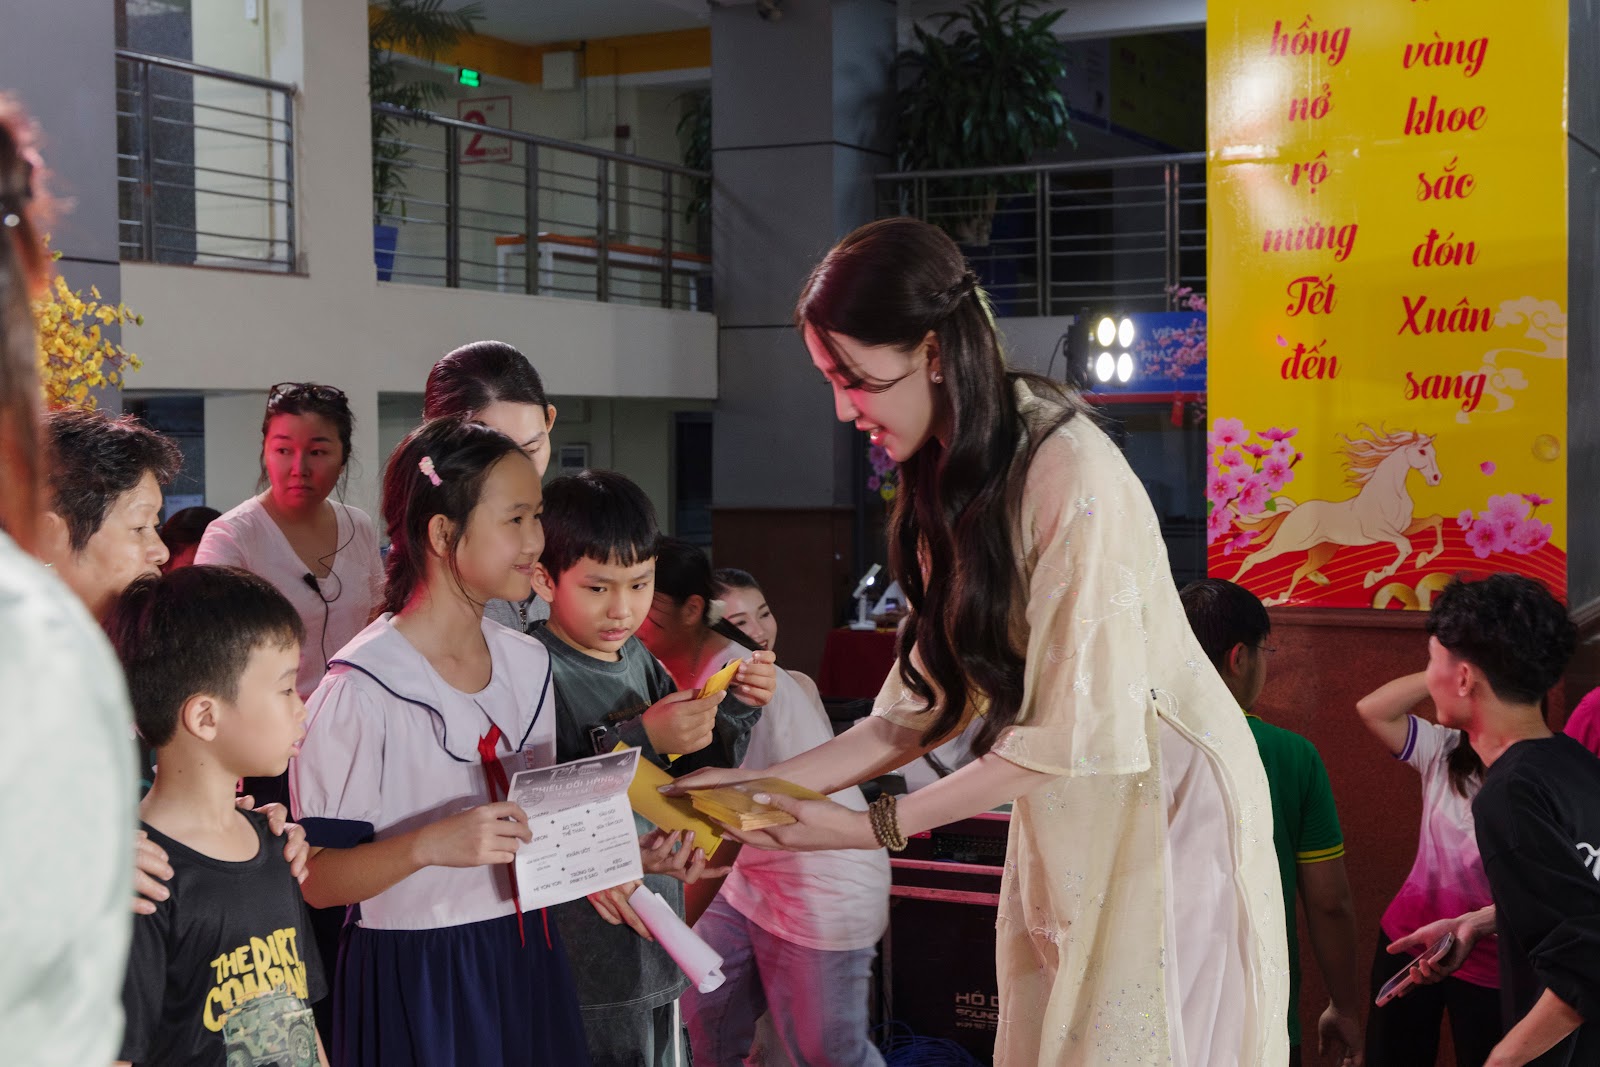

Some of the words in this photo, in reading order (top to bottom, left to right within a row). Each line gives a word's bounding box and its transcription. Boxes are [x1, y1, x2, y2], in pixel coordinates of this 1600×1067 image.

[1269, 14, 1352, 67] hồng
[1402, 31, 1489, 78] vàng
[1288, 82, 1334, 122] nở
[1403, 95, 1489, 136] khoe
[1290, 150, 1333, 195] rộ
[1416, 155, 1476, 202] sắc
[1262, 216, 1359, 263] mừng
[1412, 229, 1480, 268] đón
[1285, 273, 1337, 318] Tết
[1397, 295, 1496, 336] Xuân
[1280, 338, 1343, 380] đến
[1403, 371, 1488, 413] sang
[210, 945, 254, 984] THE
[250, 927, 300, 985] DIRT
